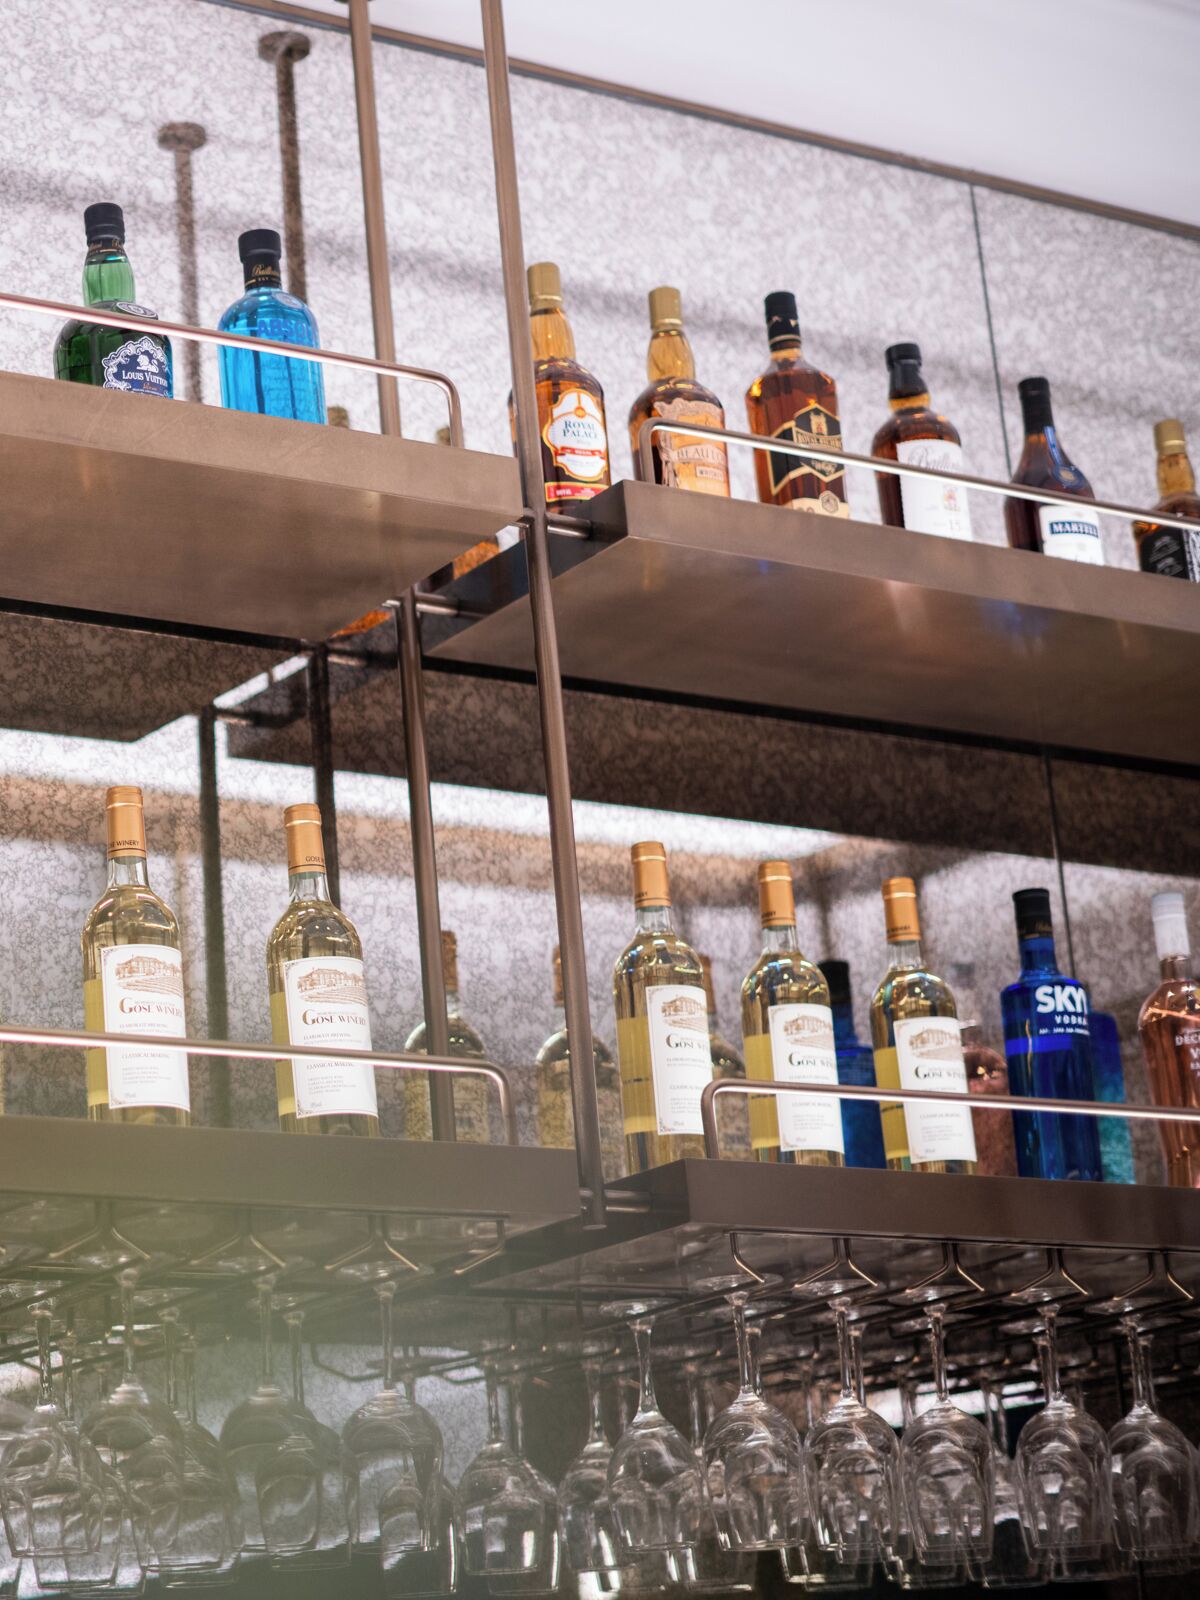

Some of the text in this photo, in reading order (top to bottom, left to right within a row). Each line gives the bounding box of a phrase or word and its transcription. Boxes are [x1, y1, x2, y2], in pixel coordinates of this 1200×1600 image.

[122, 370, 144, 380] LOUIS
[145, 373, 168, 387] VUITTON
[564, 420, 595, 431] ROYAL
[563, 428, 598, 439] PALACE
[116, 839, 140, 847] WINERY
[119, 996, 151, 1014] GOSE
[302, 1008, 336, 1025] GOSE
[1055, 1015, 1088, 1026] VODKA
